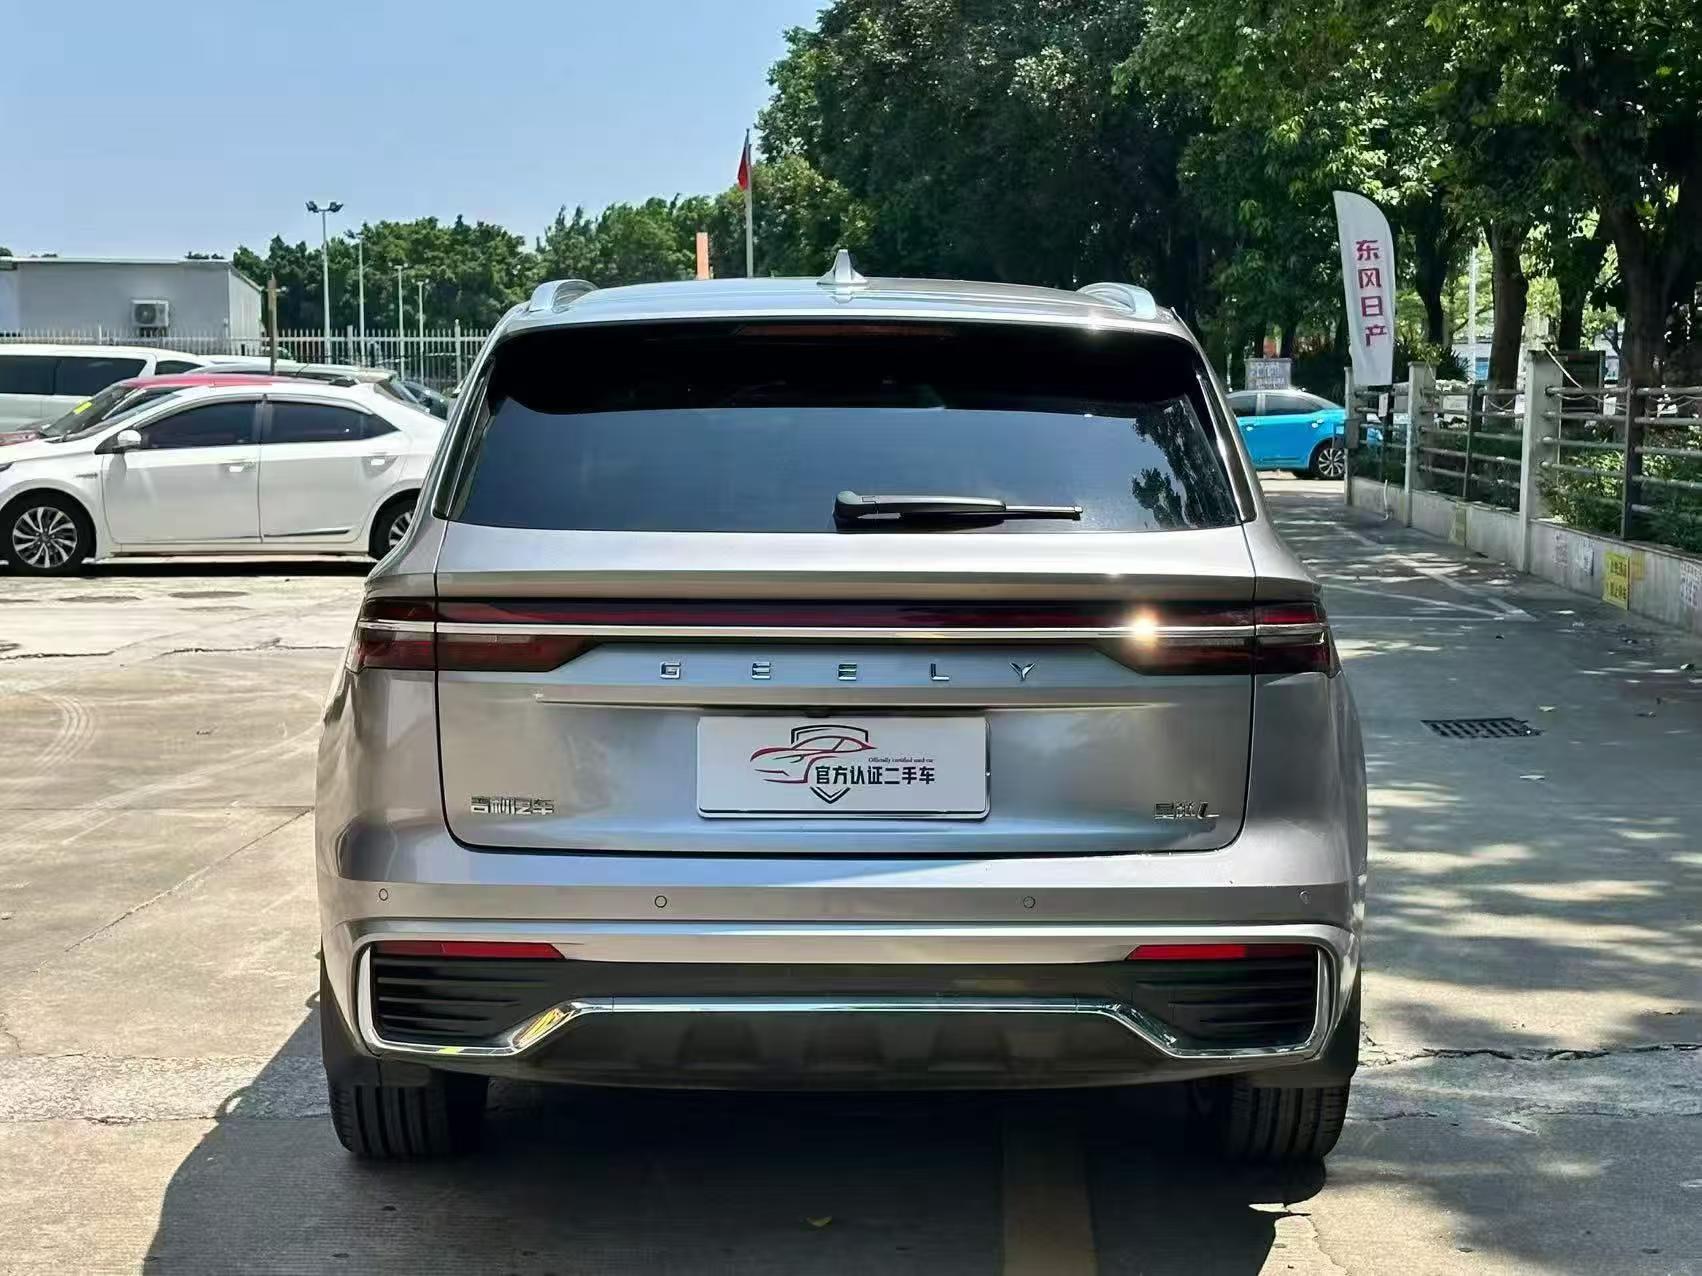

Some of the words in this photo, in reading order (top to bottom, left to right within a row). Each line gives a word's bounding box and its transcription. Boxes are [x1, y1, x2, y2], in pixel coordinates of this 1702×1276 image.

[1356, 239, 1387, 346] 东风日产
[660, 661, 1036, 682] GEELY
[816, 766, 935, 784] 官方认证二手车
